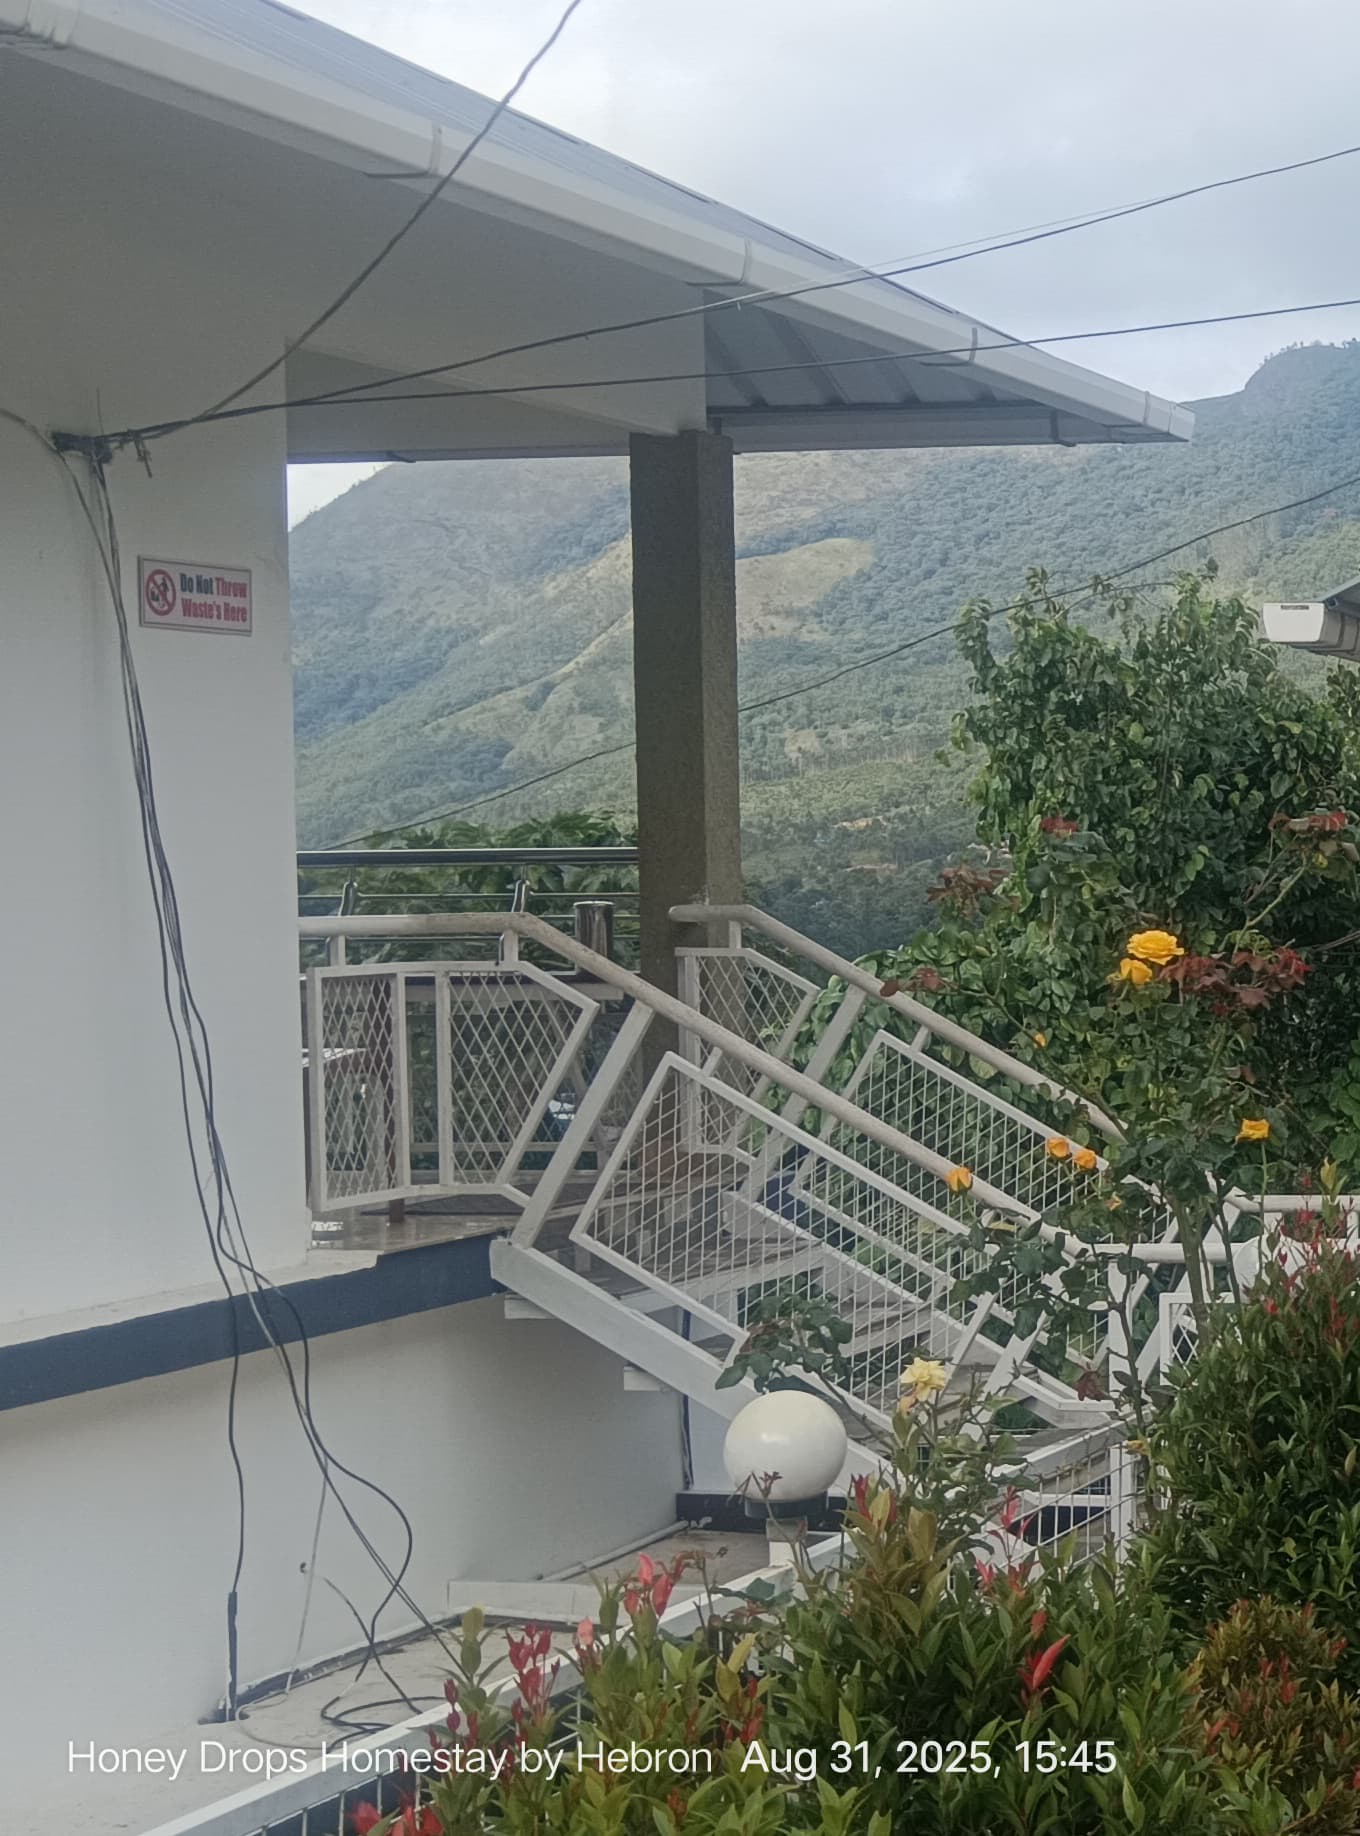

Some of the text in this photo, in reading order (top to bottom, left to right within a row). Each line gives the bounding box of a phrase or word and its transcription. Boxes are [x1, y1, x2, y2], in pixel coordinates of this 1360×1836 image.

[179, 573, 248, 598] Do Not Throw
[181, 599, 247, 623] Waste's Here
